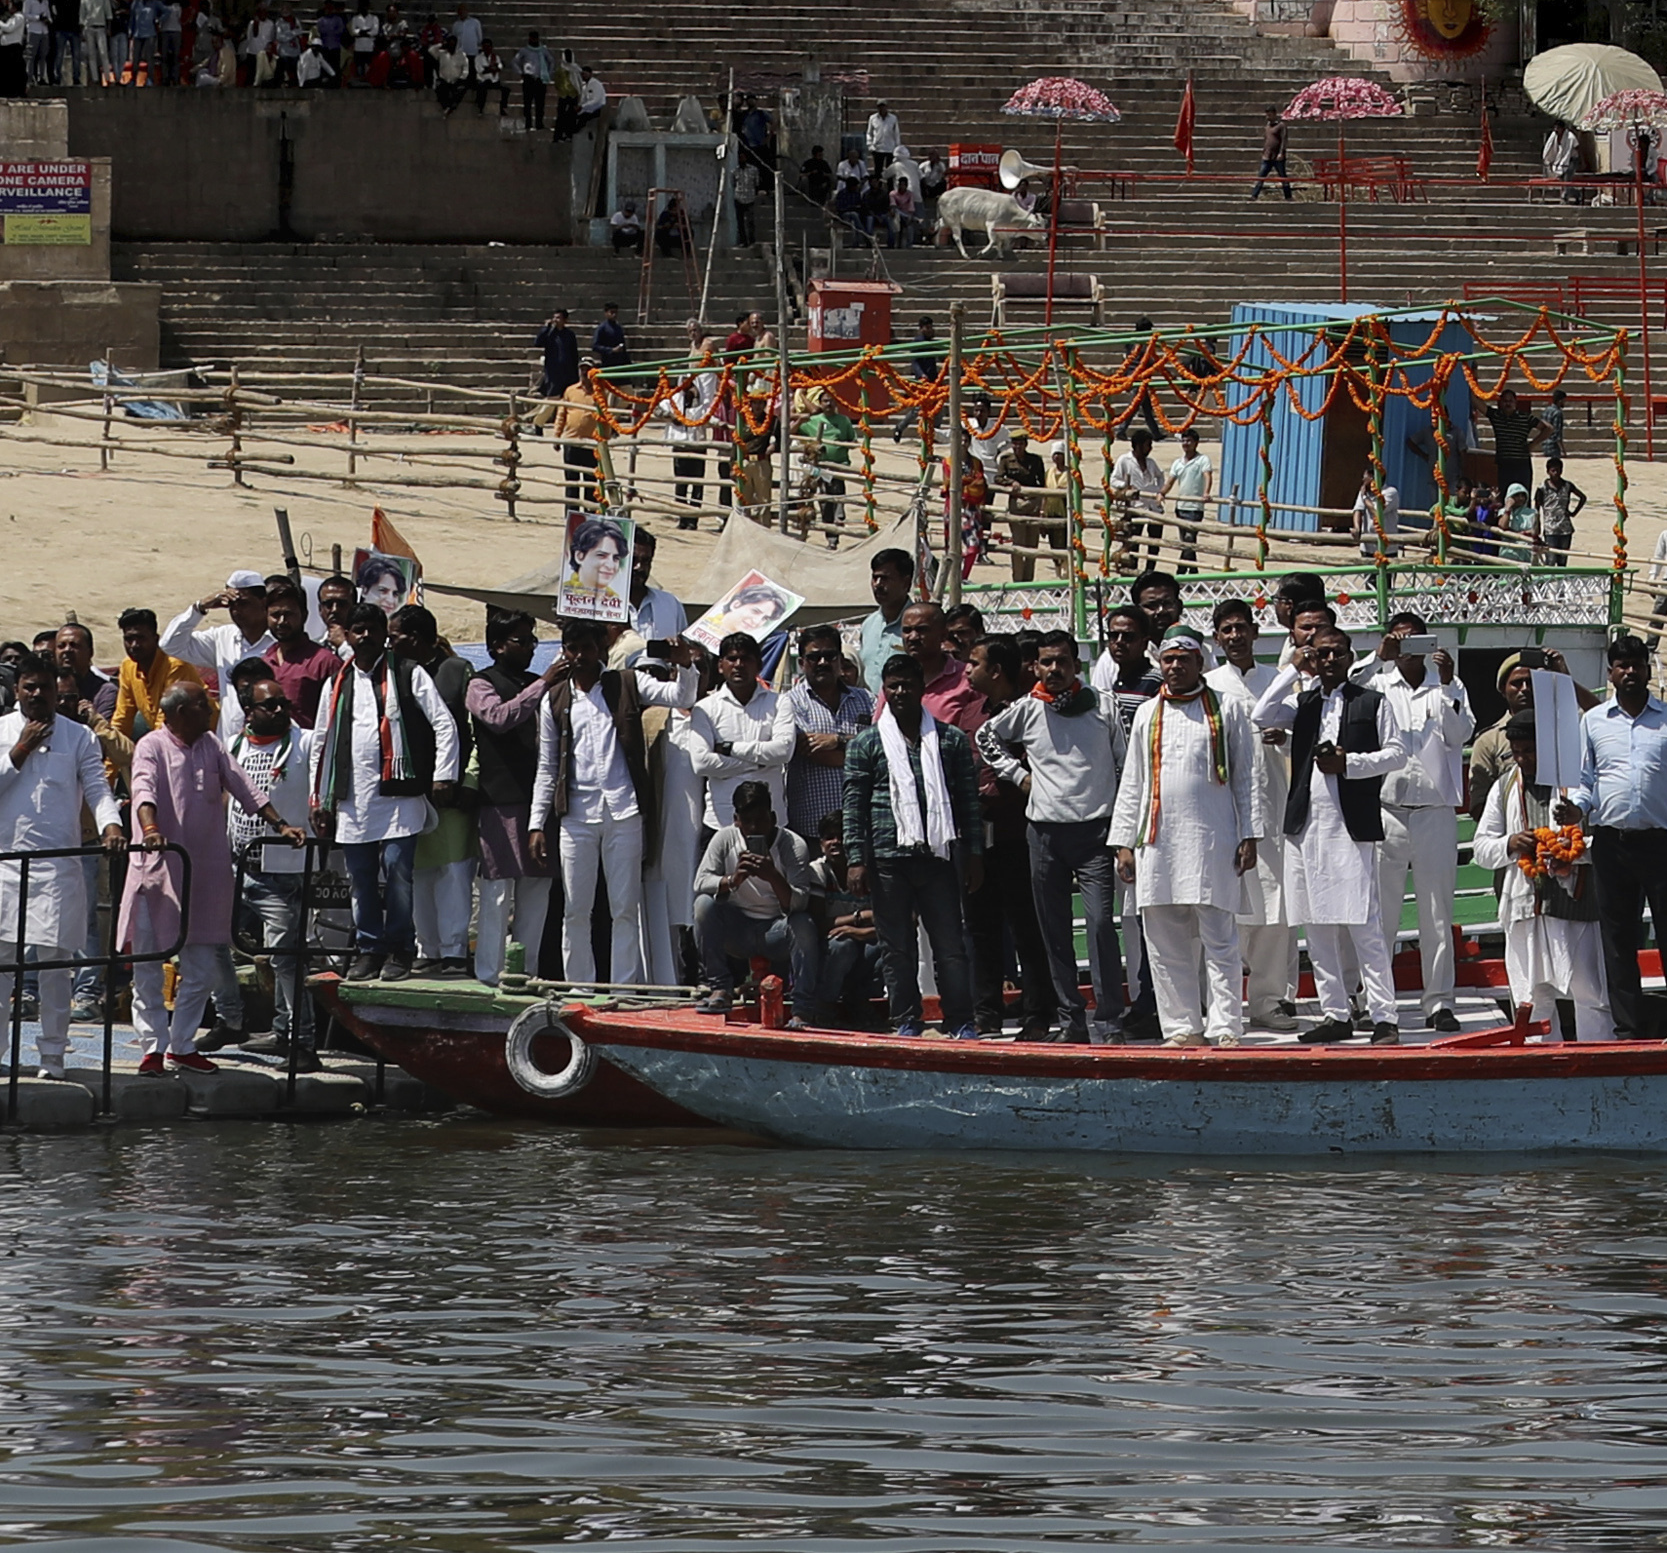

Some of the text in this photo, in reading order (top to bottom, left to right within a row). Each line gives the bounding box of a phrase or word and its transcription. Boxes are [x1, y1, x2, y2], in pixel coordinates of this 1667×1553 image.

[8, 164, 87, 174] ARE UNDER
[27, 176, 85, 185] CAMERA
[565, 594, 622, 608] फूलन देवी
